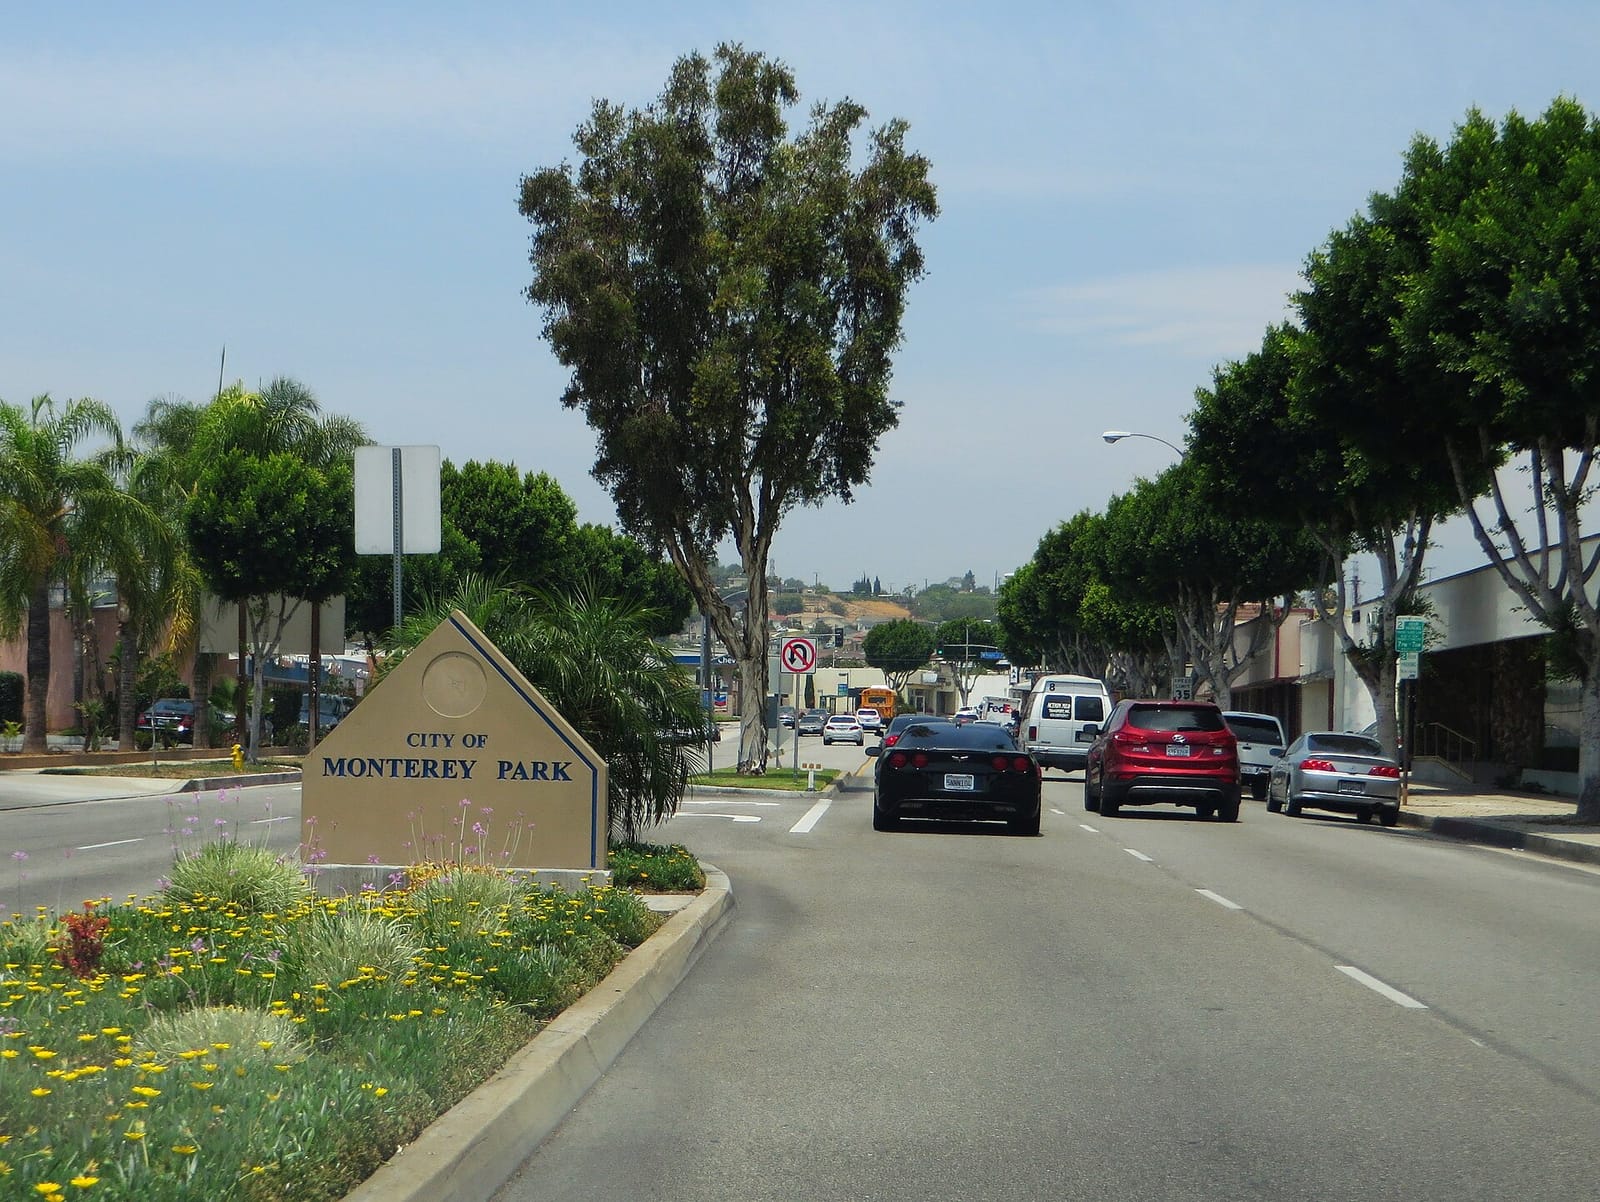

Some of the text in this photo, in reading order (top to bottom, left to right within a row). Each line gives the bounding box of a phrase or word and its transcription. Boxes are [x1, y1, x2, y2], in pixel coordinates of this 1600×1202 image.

[717, 656, 737, 664] Chev
[1049, 682, 1056, 692] 8
[1175, 690, 1190, 700] 35
[407, 733, 488, 748] CITY OF
[322, 757, 573, 782] MONTEREY PARK
